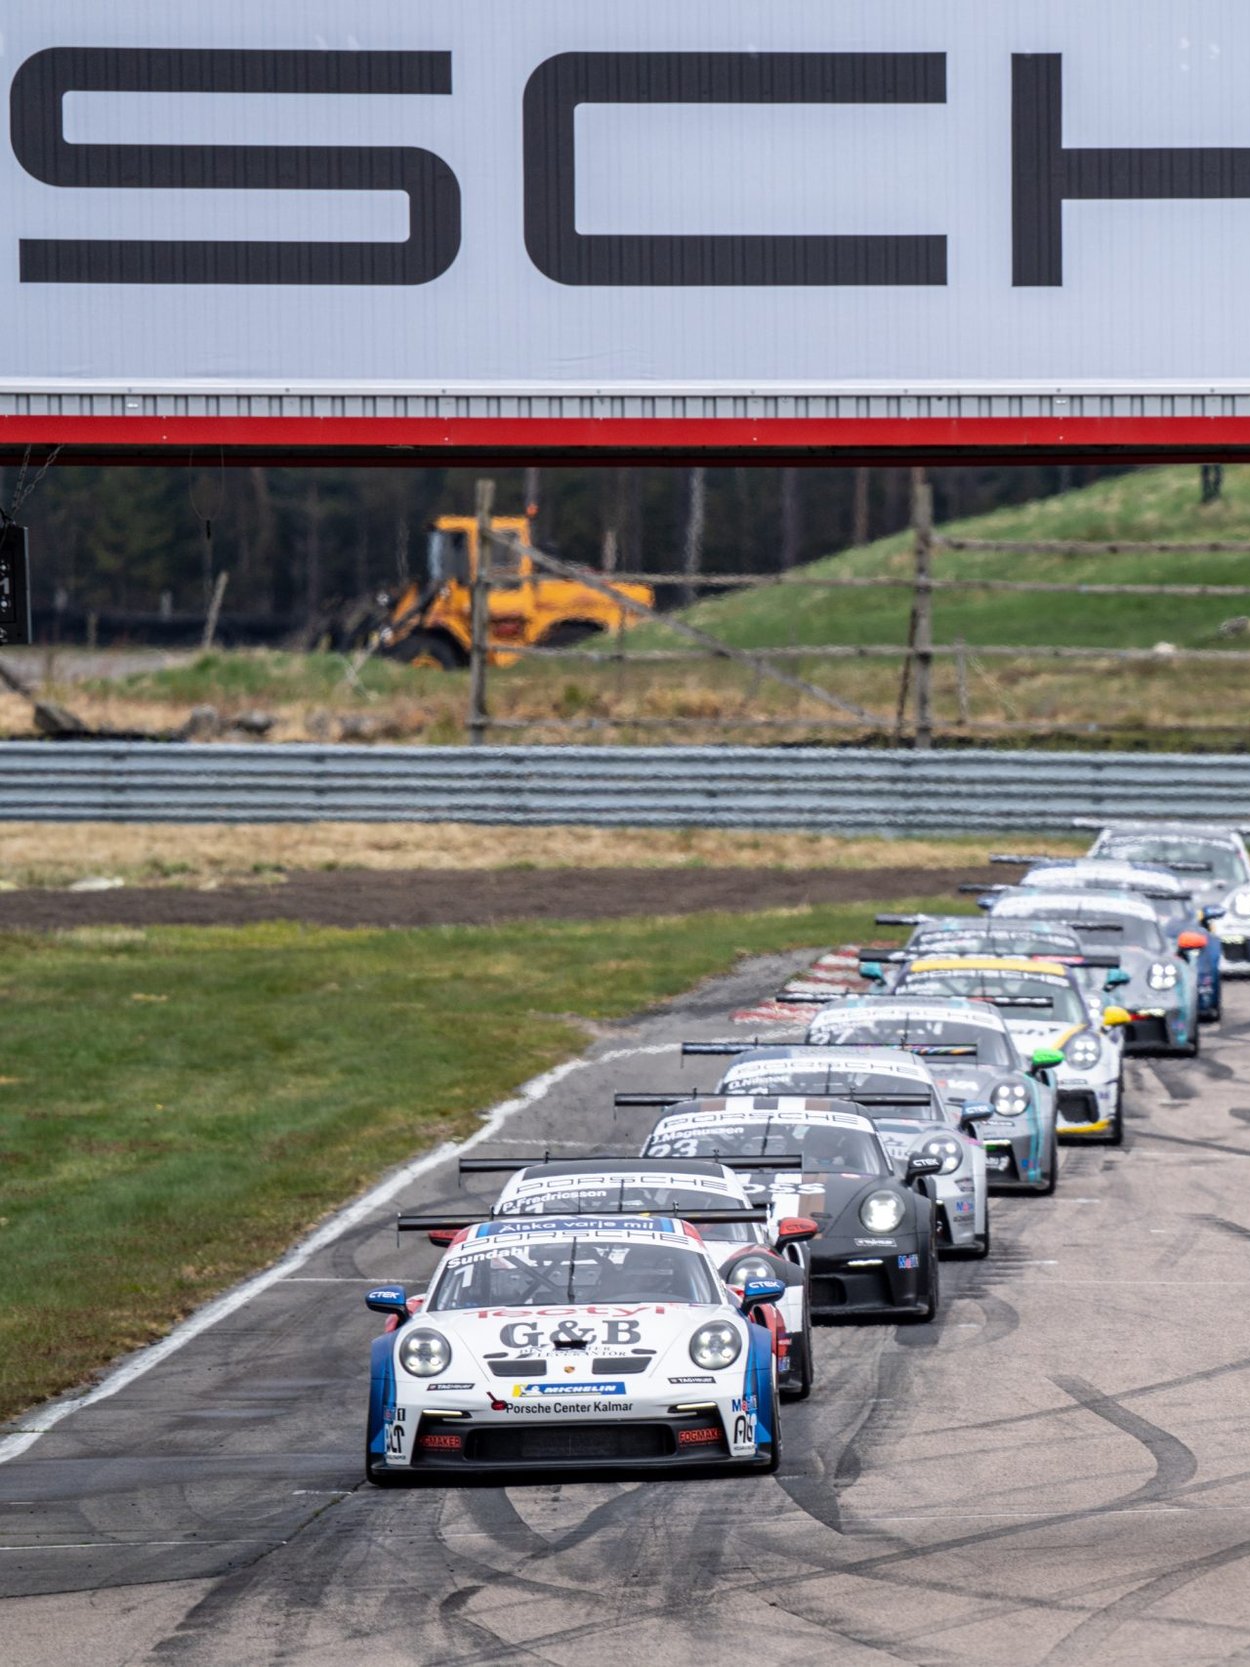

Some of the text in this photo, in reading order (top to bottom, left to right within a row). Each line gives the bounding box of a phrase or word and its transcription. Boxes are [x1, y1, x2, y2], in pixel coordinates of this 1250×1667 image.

[663, 1110, 860, 1130] PORSCHE
[517, 1175, 730, 1194] PORSCHE
[499, 1219, 654, 1233] Älska varje mil
[460, 1230, 690, 1250] PORSCHE
[447, 1244, 531, 1270] Sundahl
[453, 1263, 475, 1288] 1
[749, 1280, 780, 1290] CTEK
[368, 1290, 400, 1300] CTEK
[499, 1319, 642, 1350] G&B
[544, 1385, 617, 1394] MICHELIN
[506, 1401, 634, 1415] Porsche Center Kalmar
